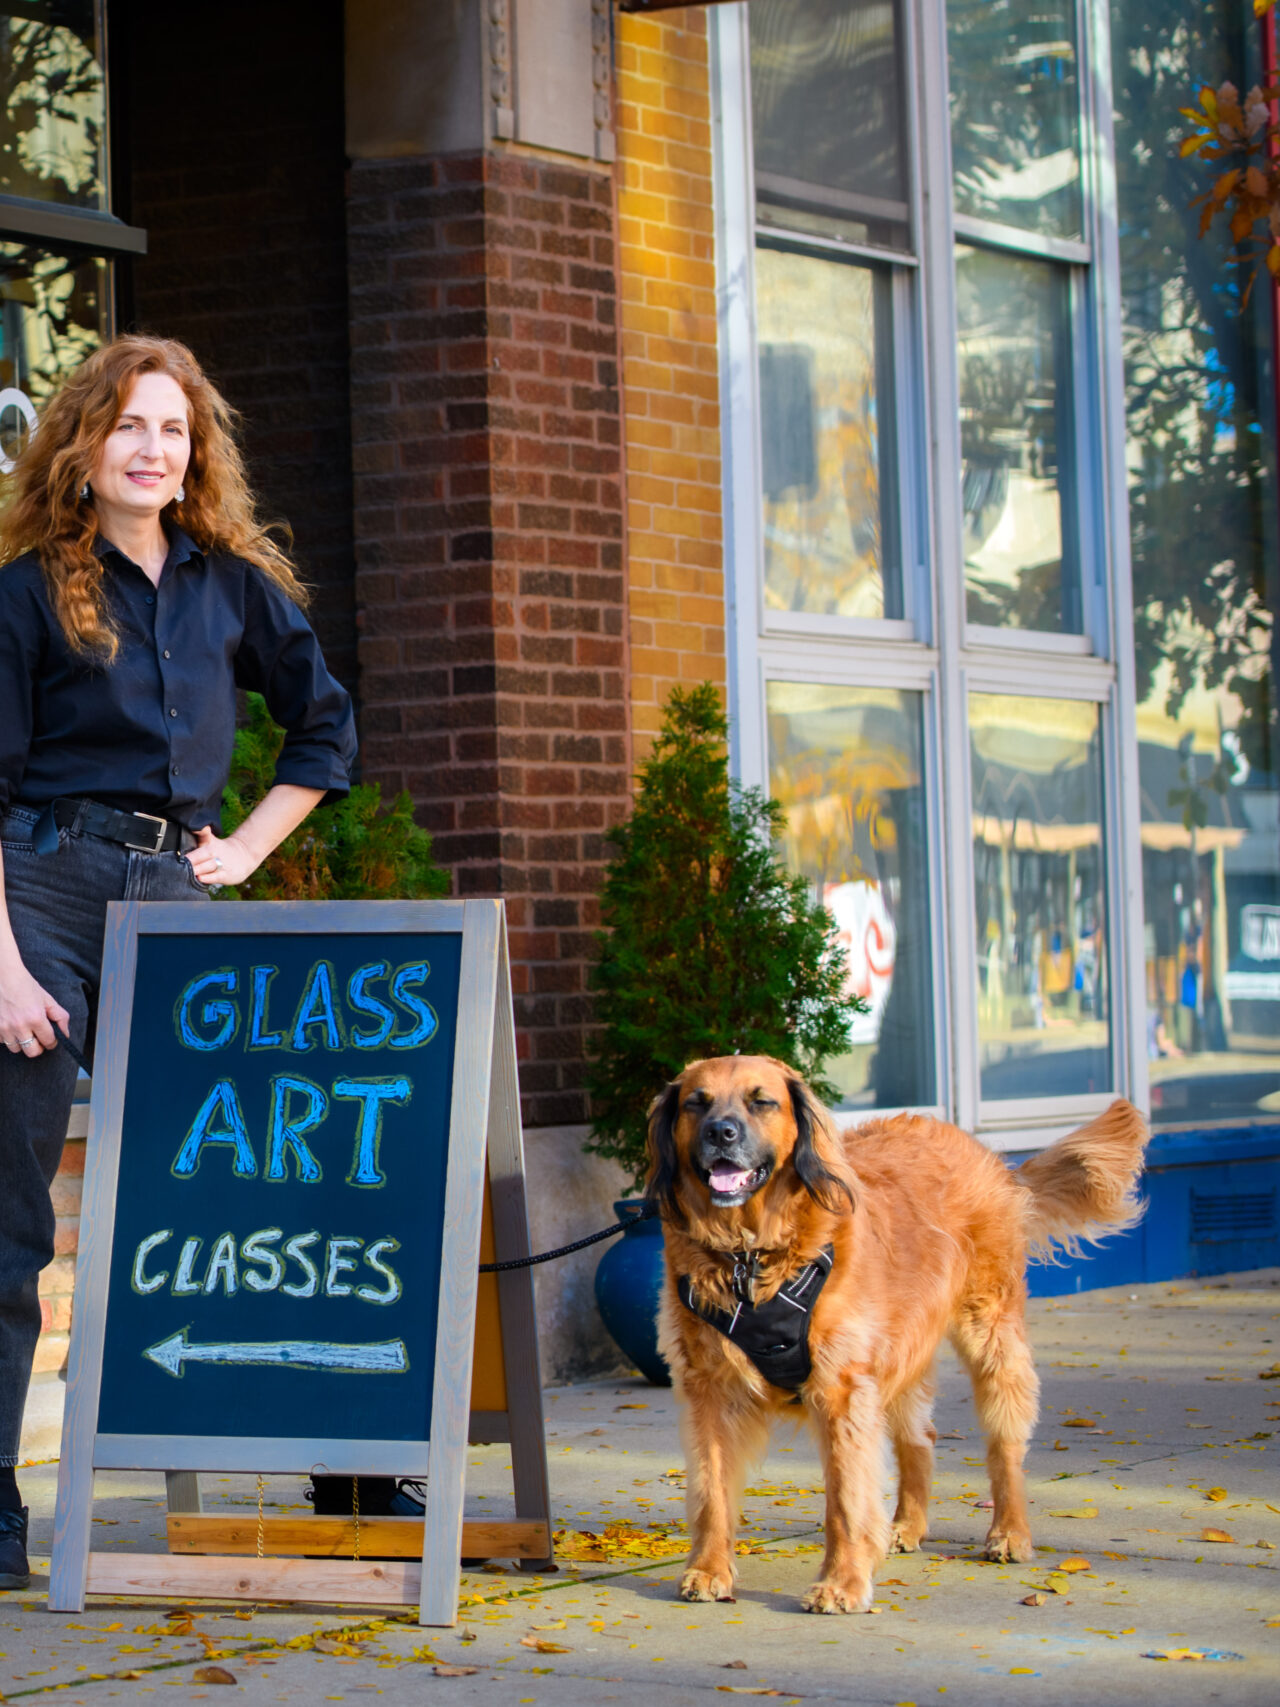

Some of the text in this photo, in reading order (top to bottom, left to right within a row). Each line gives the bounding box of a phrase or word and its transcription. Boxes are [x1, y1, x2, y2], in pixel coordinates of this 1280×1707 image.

[175, 960, 438, 1051] GLASS
[171, 1075, 413, 1189] ART
[131, 1227, 402, 1305] CLASSES
